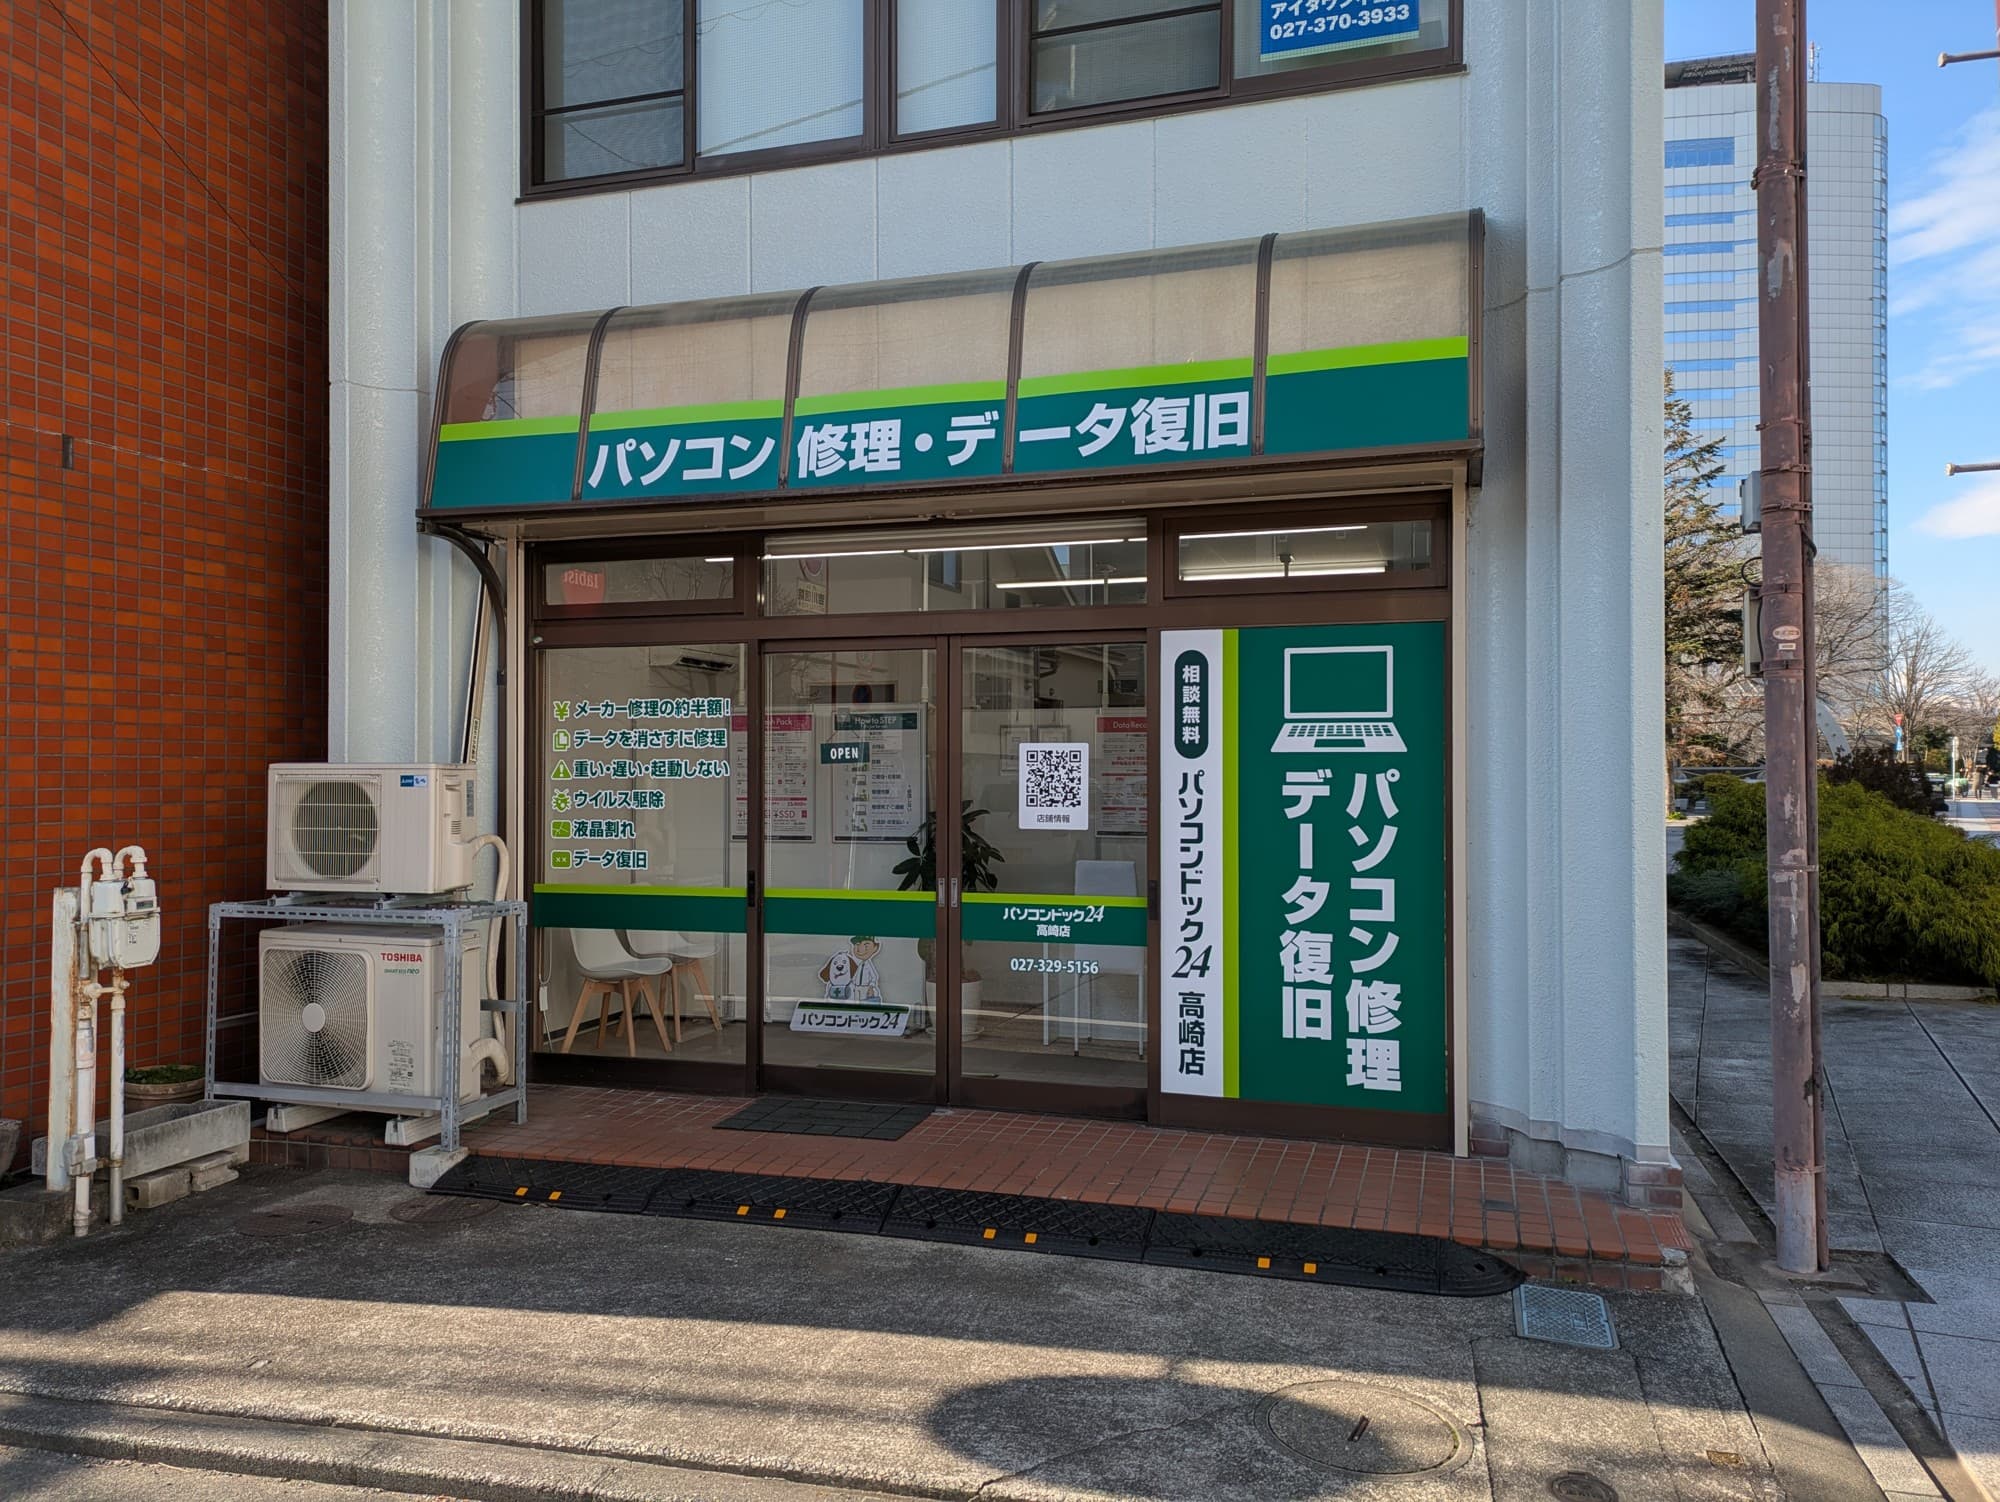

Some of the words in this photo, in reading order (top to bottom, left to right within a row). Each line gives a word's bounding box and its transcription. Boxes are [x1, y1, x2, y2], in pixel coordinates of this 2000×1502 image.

[1269, 4, 1410, 40] 027-370-3933
[1182, 664, 1201, 745] 相談無料
[573, 728, 727, 749] データを消さずに修理
[830, 747, 859, 760] OPEN
[573, 759, 731, 779] 重い・遅い・起動しない
[573, 790, 666, 809] ウイルス駆除
[1036, 814, 1071, 824] 店舗情報
[573, 820, 636, 839] 液晶割れ
[573, 850, 648, 870] データ復旧
[1171, 769, 1213, 979] パソコンドック24
[1003, 905, 1105, 922] パソコンドック24
[1279, 768, 1335, 1041] データ復旧
[1036, 924, 1071, 938] 高崎店
[1345, 768, 1402, 1092] パソコン修理
[380, 952, 423, 963] TOSHIBA
[1010, 958, 1099, 975] 027-329-5156
[801, 1012, 901, 1029] パソコンドック24
[1178, 990, 1206, 1076] 高崎店
